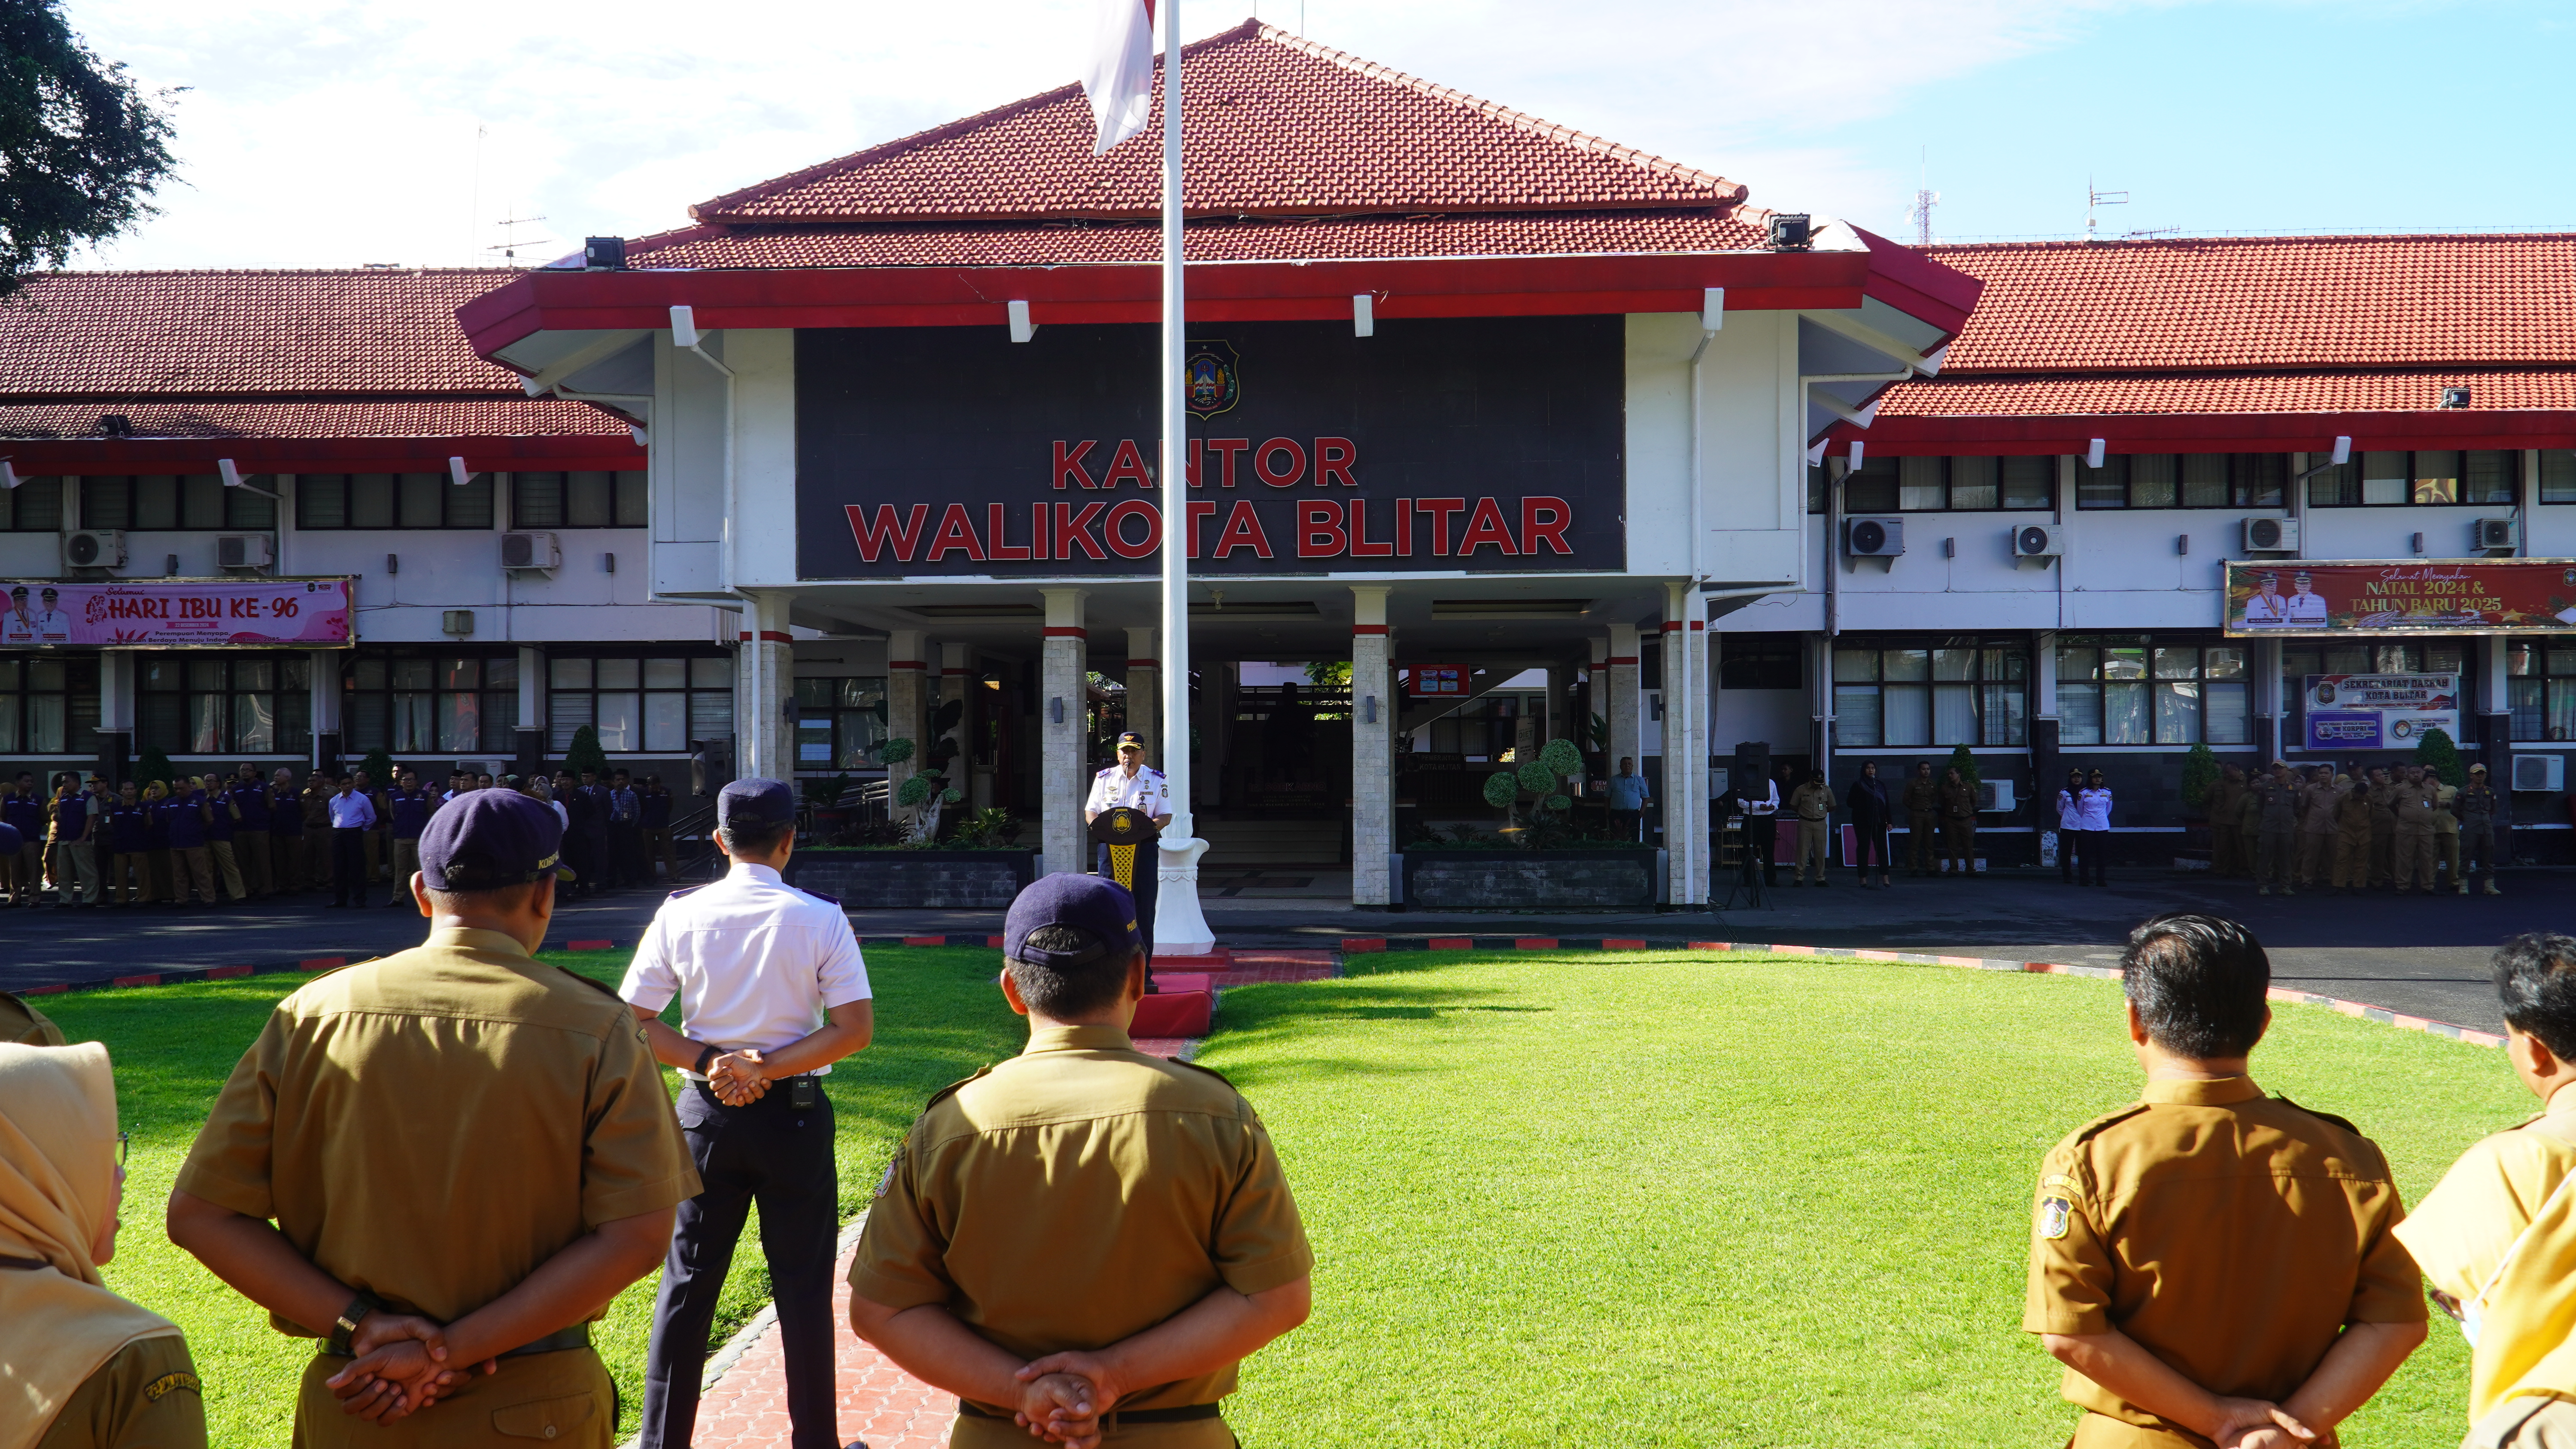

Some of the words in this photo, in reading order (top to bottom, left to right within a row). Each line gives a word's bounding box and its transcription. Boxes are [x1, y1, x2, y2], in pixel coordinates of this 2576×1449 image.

[1052, 437, 1358, 489] KANTOR
[844, 499, 1274, 563] WALIKOTA
[1297, 496, 1574, 558] BLITAR
[2380, 568, 2421, 582] Selamat
[2366, 581, 2420, 595] NATAL
[2424, 581, 2467, 594] 2024
[2472, 581, 2485, 594] &
[108, 598, 170, 618] HARI
[179, 598, 222, 618] IBU
[2350, 598, 2406, 612] TAHUN
[2410, 598, 2456, 611] BARU
[2460, 597, 2502, 611] 2025
[2344, 679, 2409, 689] SEKRETARIAT
[2411, 678, 2448, 688] DAERAH
[2366, 690, 2390, 700] KOTA
[2393, 690, 2427, 699] BLITAR
[1519, 730, 1532, 739] DIET
[1264, 782, 1326, 791] SOEKARNO
[538, 851, 559, 870] KORP
